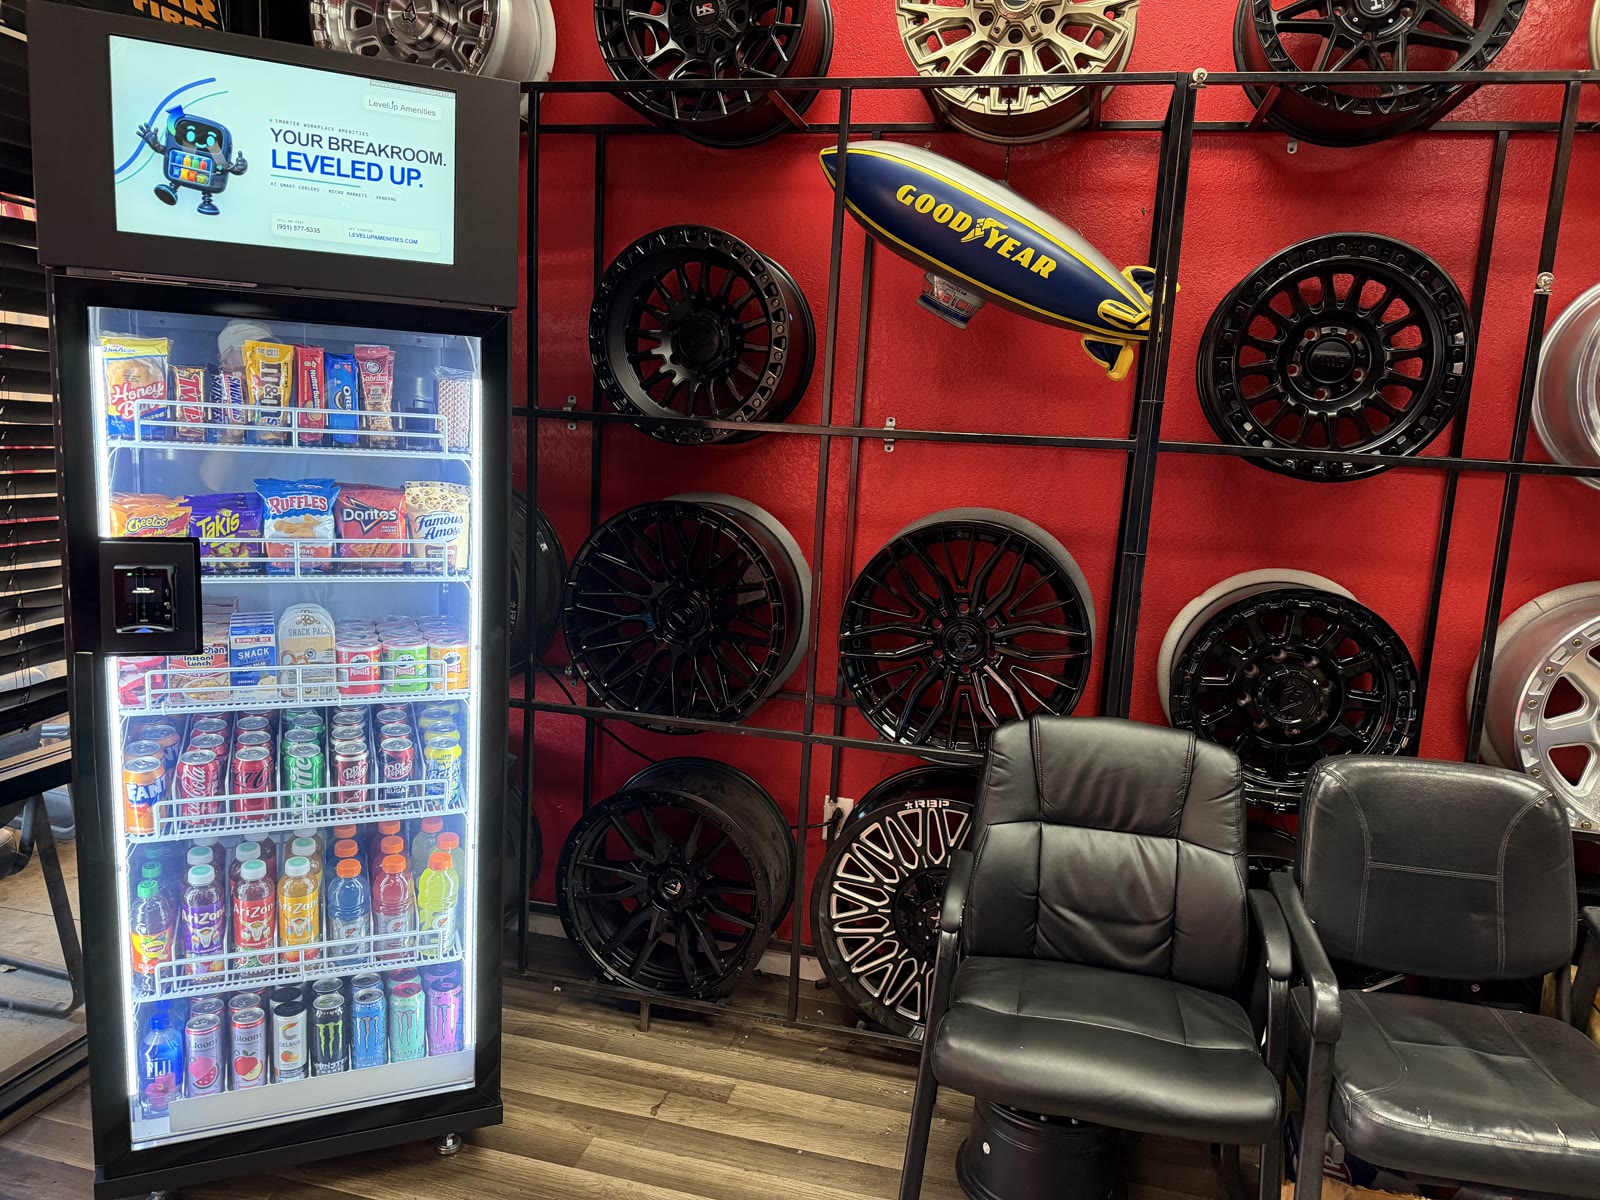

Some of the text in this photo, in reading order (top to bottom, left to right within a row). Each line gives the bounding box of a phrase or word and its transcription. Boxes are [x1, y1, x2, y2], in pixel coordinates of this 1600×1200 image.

[369, 99, 437, 117] LevelUp Amenities
[275, 118, 369, 137] SMARTER WORKPLACE AMENITIES
[270, 127, 447, 167] YOUR BREAKROOM.
[271, 148, 424, 188] LEVELED UP.
[276, 223, 293, 232] (951)
[348, 231, 418, 245] LEVELUPAMENITIES.COM
[309, 369, 319, 391] Nutter
[111, 382, 165, 403] Honey
[211, 374, 223, 424] SATISIES
[228, 375, 245, 423] SNICKRS
[343, 385, 353, 411] ORE
[268, 494, 328, 516] RUFFLES
[342, 507, 397, 521] Doritos
[126, 515, 169, 532] Cheetos
[196, 512, 240, 546] Takis
[414, 514, 464, 533] Famous
[284, 547, 315, 556] CHDAR
[288, 627, 330, 637] SNACK PACK
[237, 647, 270, 660] SNACK
[350, 665, 370, 676] PRINGLES
[395, 666, 416, 676] PRINGLES
[126, 775, 166, 802] FANT
[233, 903, 275, 919] AriZon
[278, 896, 319, 915] AriZon
[181, 908, 225, 925] AriZon
[234, 1032, 262, 1043] Bloom
[145, 1059, 172, 1078] FIJI
